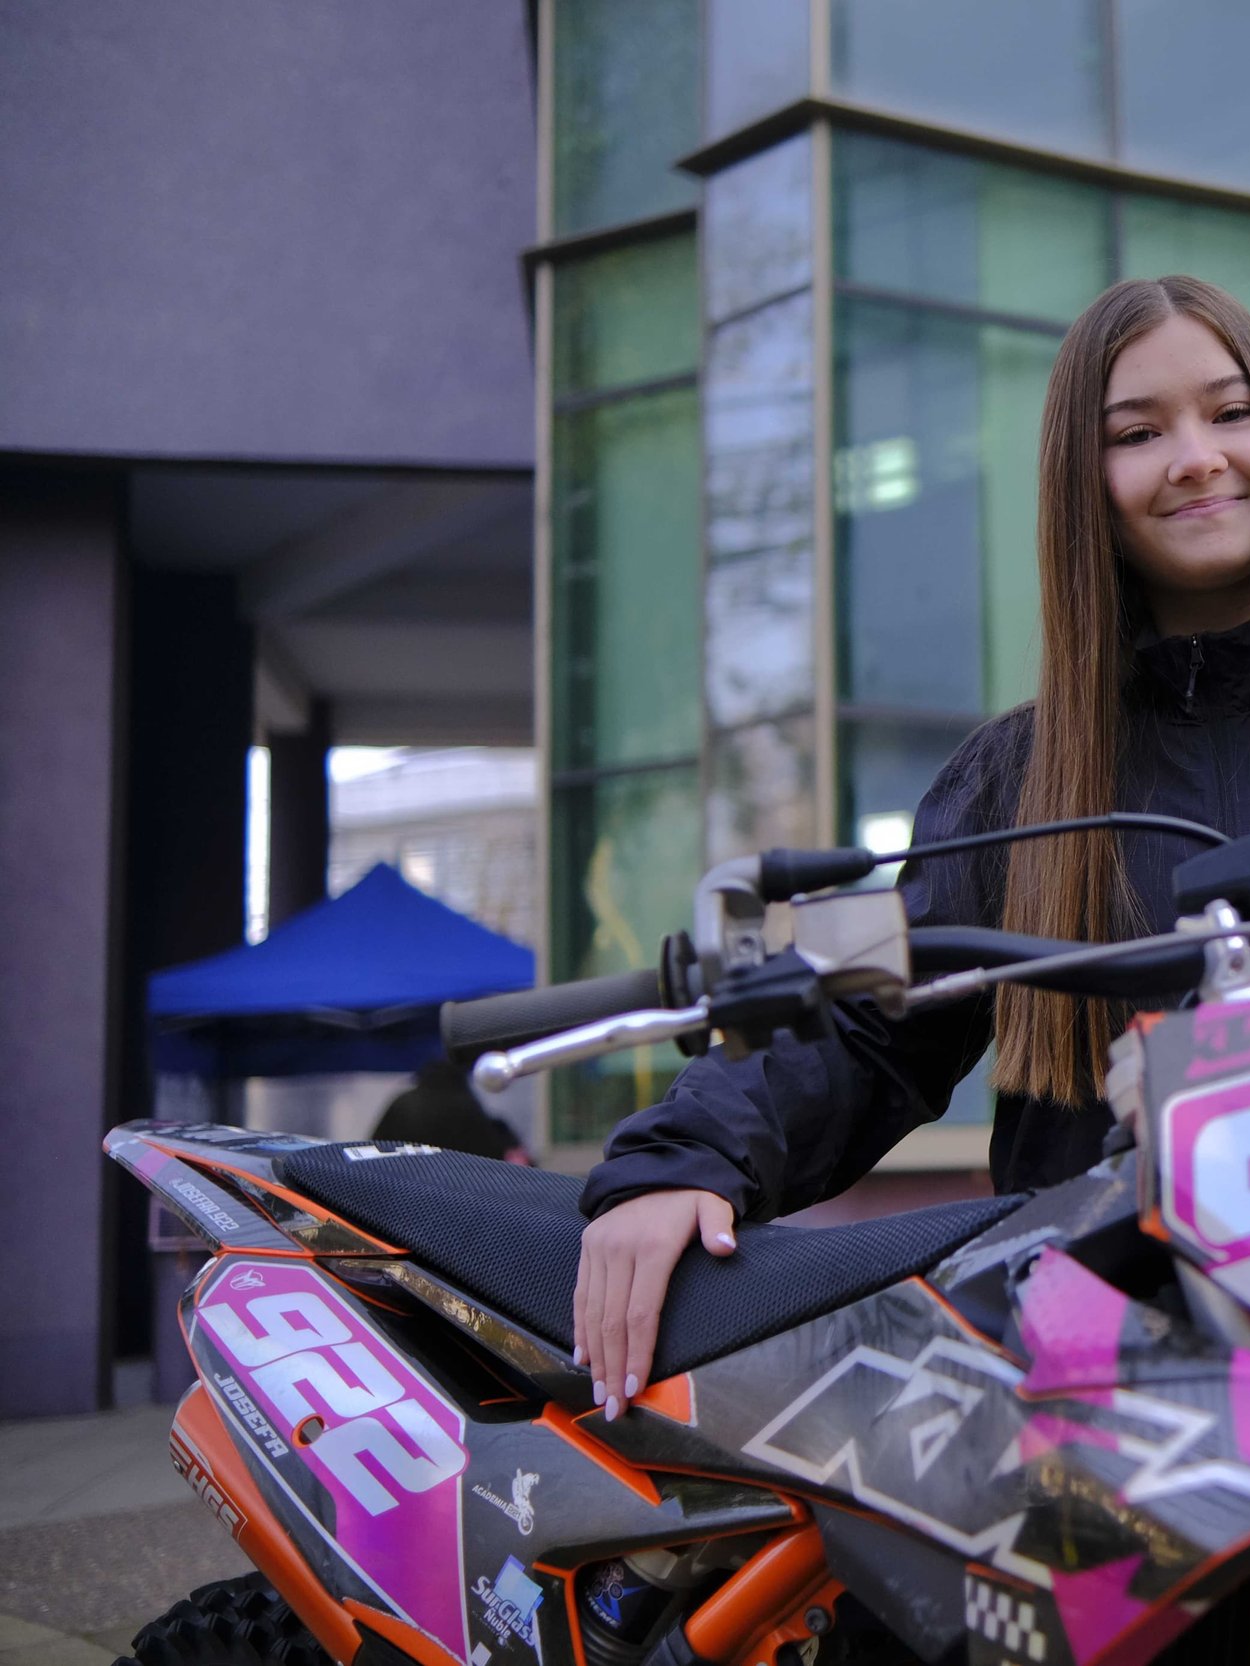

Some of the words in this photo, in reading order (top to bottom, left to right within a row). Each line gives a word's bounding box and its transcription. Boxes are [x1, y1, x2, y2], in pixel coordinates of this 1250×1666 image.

[198, 1291, 468, 1517] 922
[213, 1372, 289, 1458] JOSEFA
[186, 1464, 239, 1535] HGS
[471, 1484, 507, 1511] ACADEMIA
[483, 1607, 512, 1640] Ñuble
